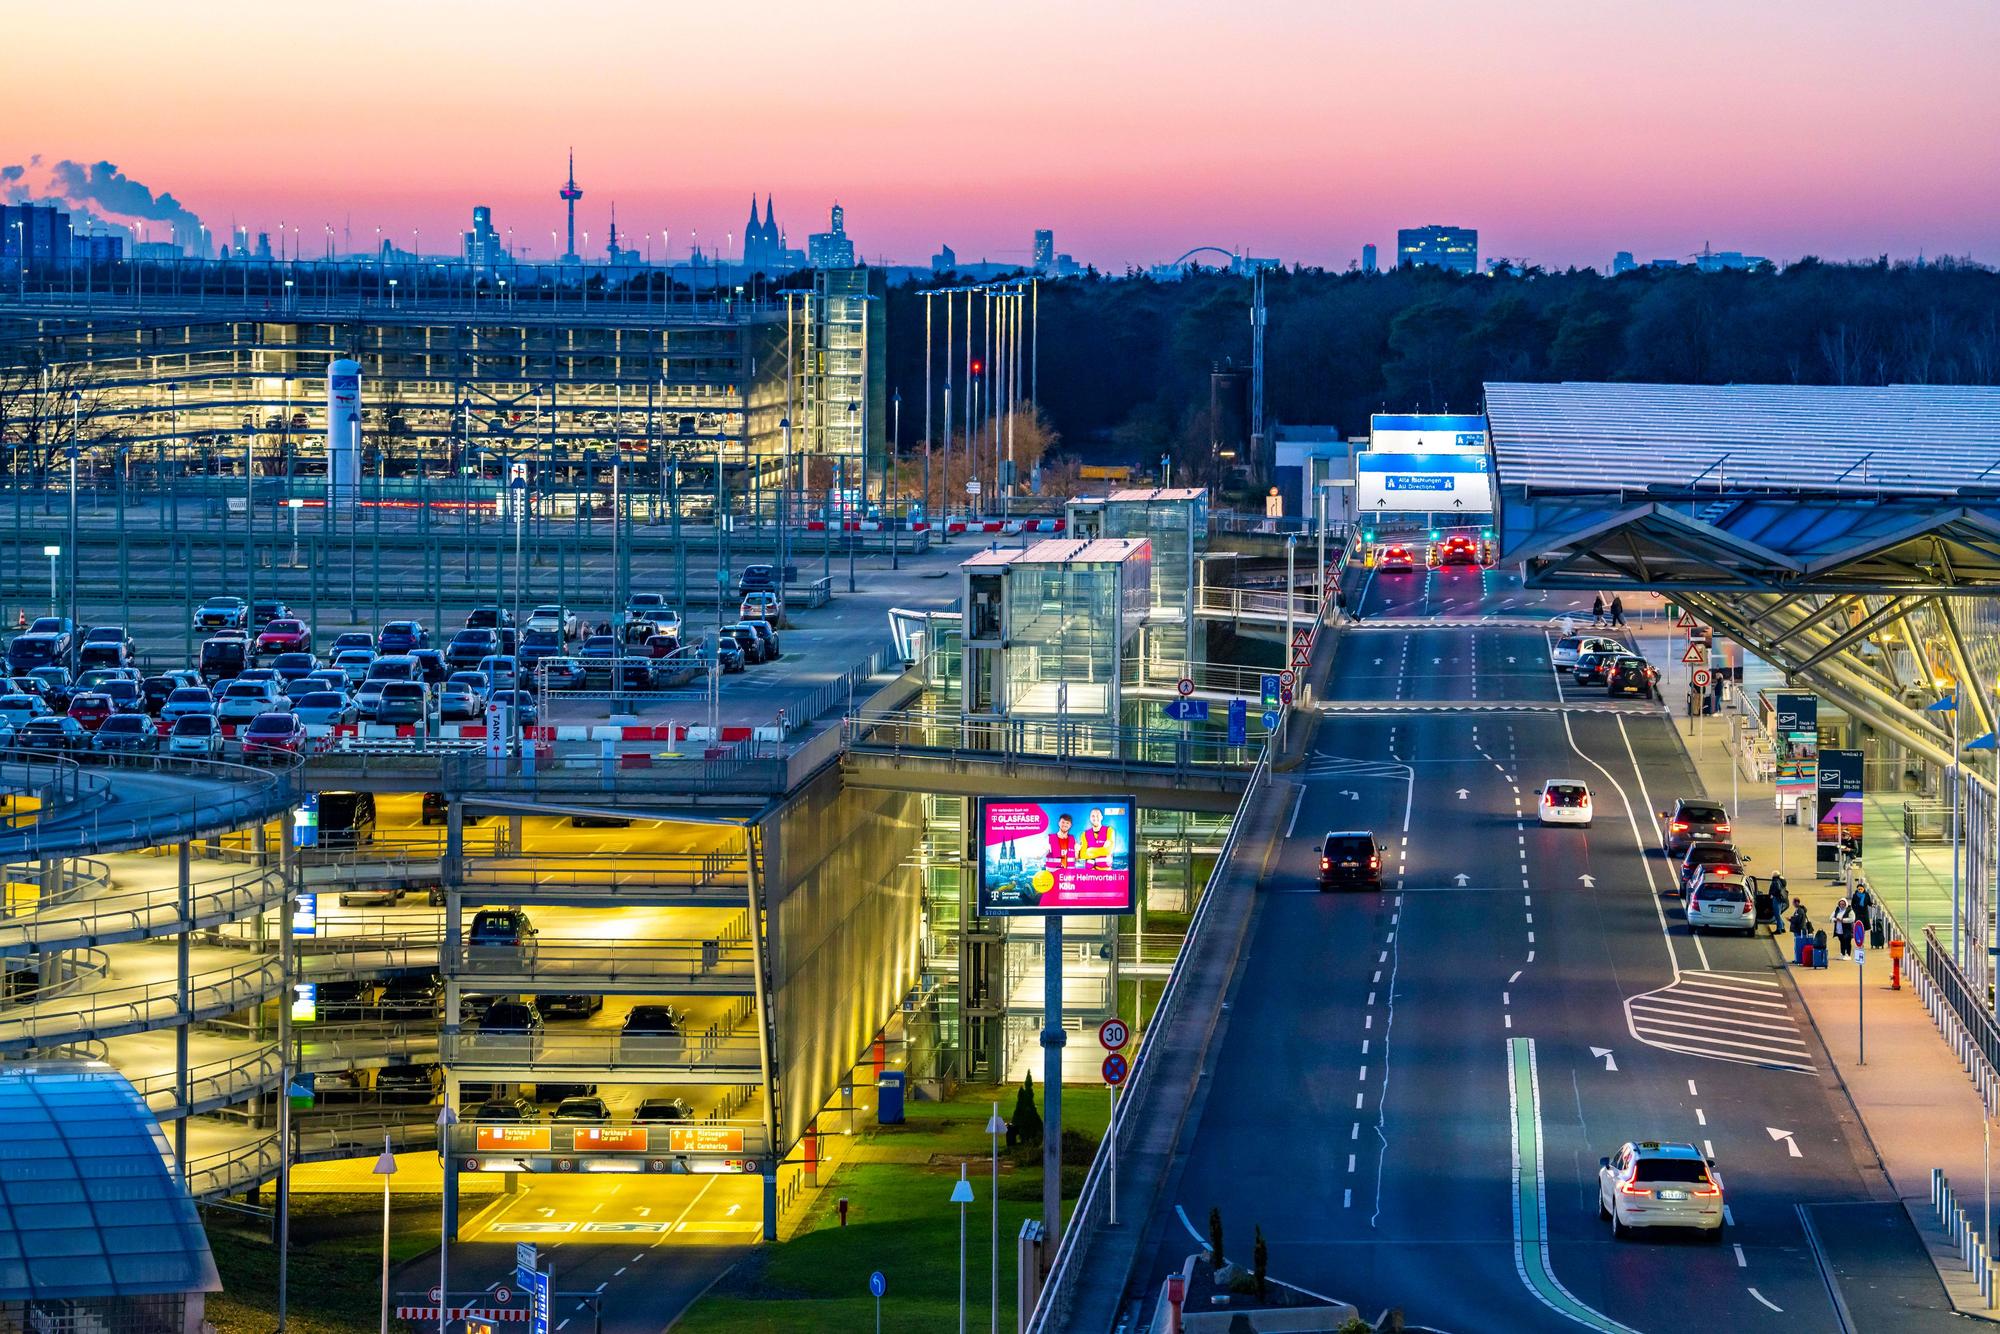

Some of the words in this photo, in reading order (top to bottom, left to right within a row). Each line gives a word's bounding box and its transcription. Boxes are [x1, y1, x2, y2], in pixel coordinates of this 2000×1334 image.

[1411, 476, 1442, 484] Richtungen
[1698, 674, 1705, 682] 30
[1180, 702, 1189, 718] P
[998, 814, 1040, 823] GLASFASER
[1059, 873, 1076, 881] Euer
[1077, 873, 1117, 881] Heimvorteil
[1058, 882, 1076, 890] Köln
[1105, 1027, 1123, 1042] 30
[697, 1130, 728, 1138] Mietwagen
[500, 1291, 506, 1299] 5
